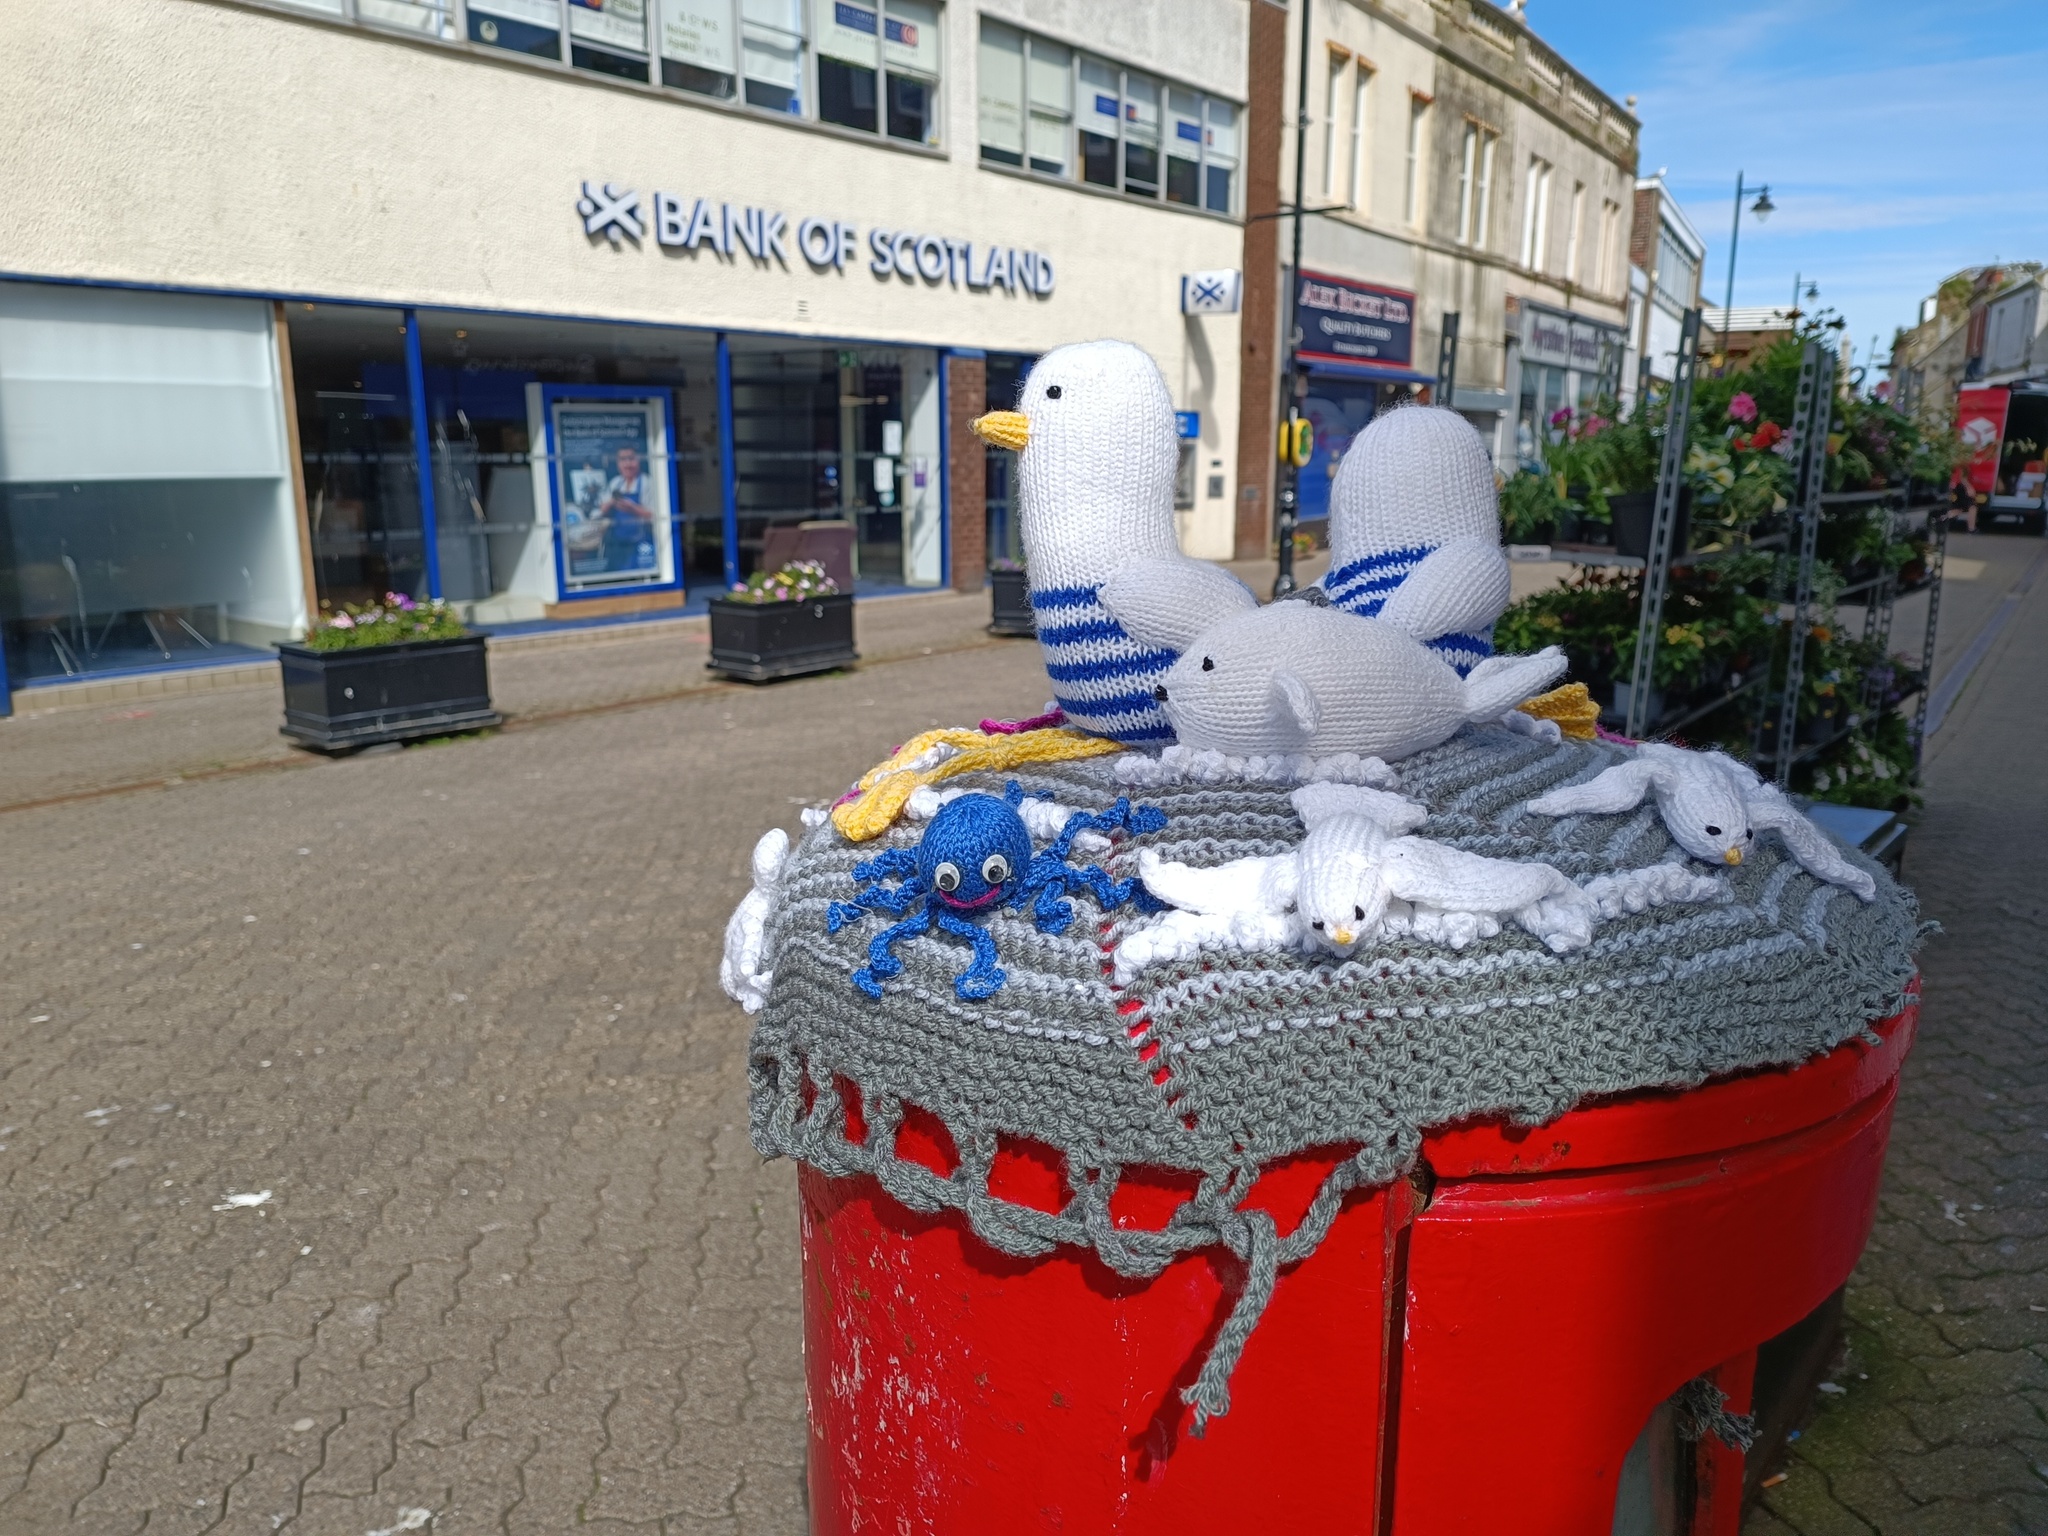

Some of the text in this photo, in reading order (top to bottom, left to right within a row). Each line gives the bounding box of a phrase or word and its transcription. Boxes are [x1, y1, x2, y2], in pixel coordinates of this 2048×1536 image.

[655, 191, 1057, 295] BANK OF SCOTLAND
